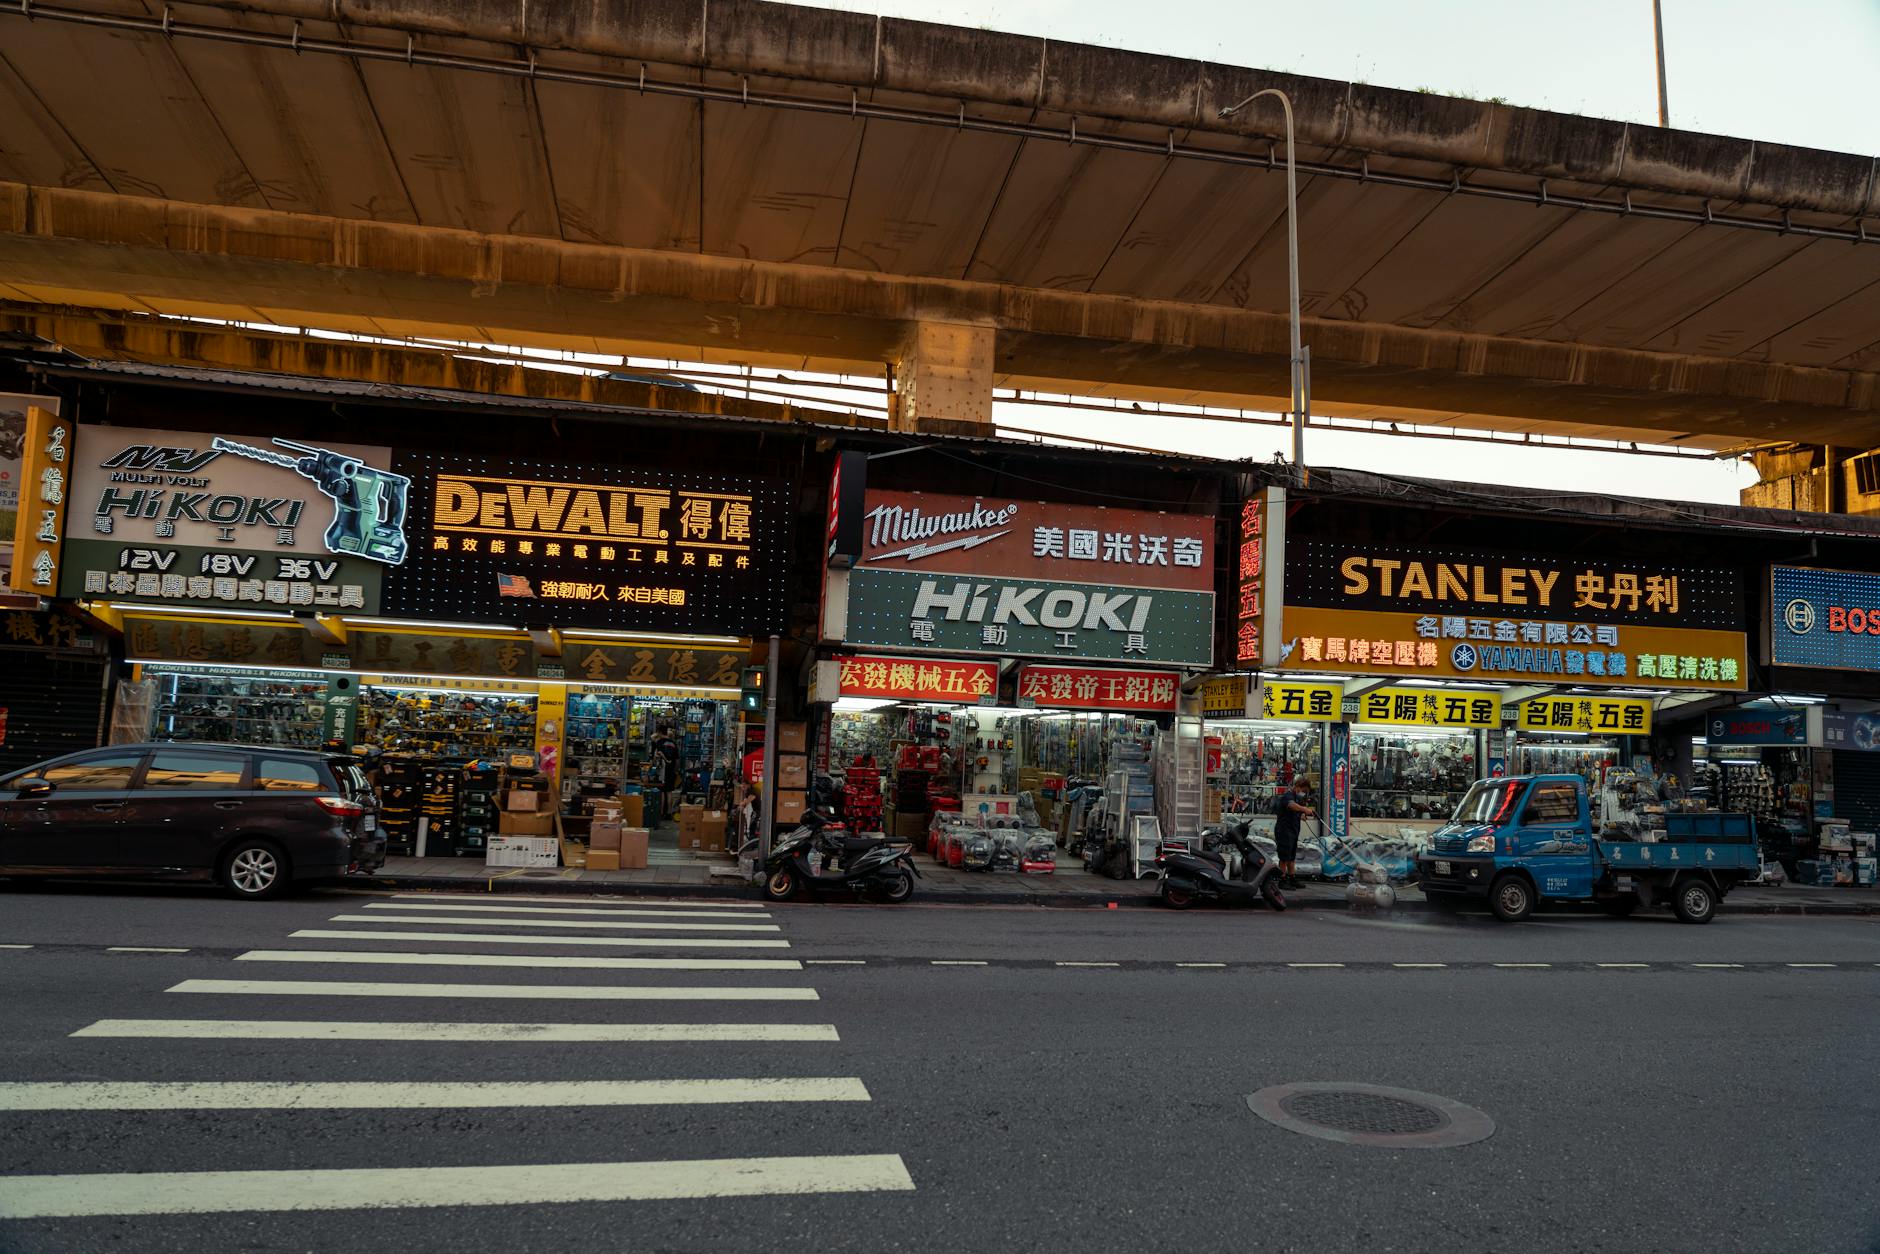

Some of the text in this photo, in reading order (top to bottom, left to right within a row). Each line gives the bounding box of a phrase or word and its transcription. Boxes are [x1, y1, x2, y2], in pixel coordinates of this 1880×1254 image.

[111, 471, 209, 488] MULTI VOLT
[95, 516, 297, 545] 電動工具
[678, 497, 752, 542] 得偉
[864, 502, 1011, 548] Milwaukee
[119, 549, 338, 580] 12V 18V 36V
[1033, 526, 1203, 568] 美國米沃奇
[84, 570, 365, 608] 日本品牌充電式電動工具
[540, 580, 686, 606] 強韌耐久 來自美國
[1236, 499, 1262, 661] 名陽五金
[1341, 556, 1680, 614] STANLEY 史丹利
[909, 619, 1148, 655] 電動工具
[1416, 616, 1618, 647] 名陽五金有限公司
[1300, 636, 1439, 667] 寶馬牌空壓機
[1477, 645, 1562, 673] YAMAHA
[1636, 653, 1739, 682] 高壓清洗機
[839, 660, 996, 697] 宏發機械五金
[1023, 670, 1177, 704] 宏發帝王鋁梯
[1343, 704, 1359, 712] 238
